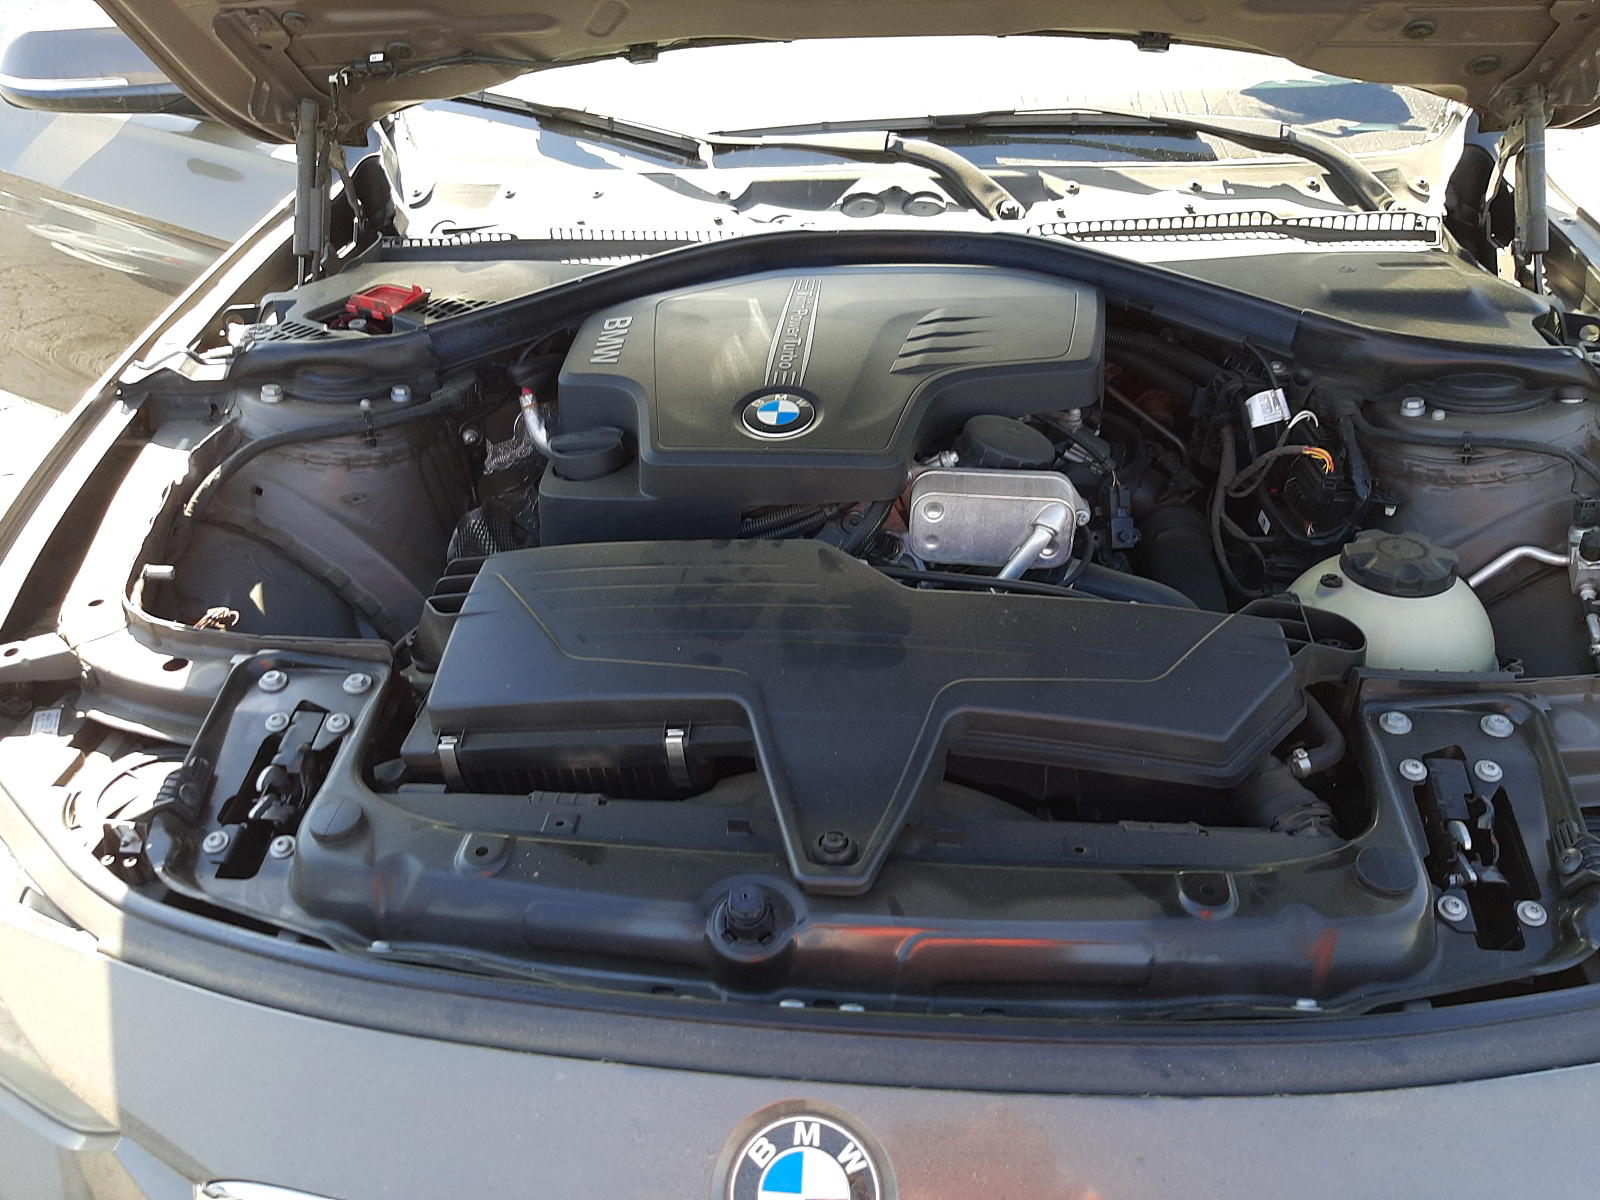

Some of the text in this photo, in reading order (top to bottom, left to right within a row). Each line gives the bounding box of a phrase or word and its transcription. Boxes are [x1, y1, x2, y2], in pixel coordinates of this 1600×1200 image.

[590, 316, 633, 363] BMW
[778, 338, 802, 369] Turbo
[751, 393, 810, 408] BMW
[748, 1121, 868, 1175] BMW
